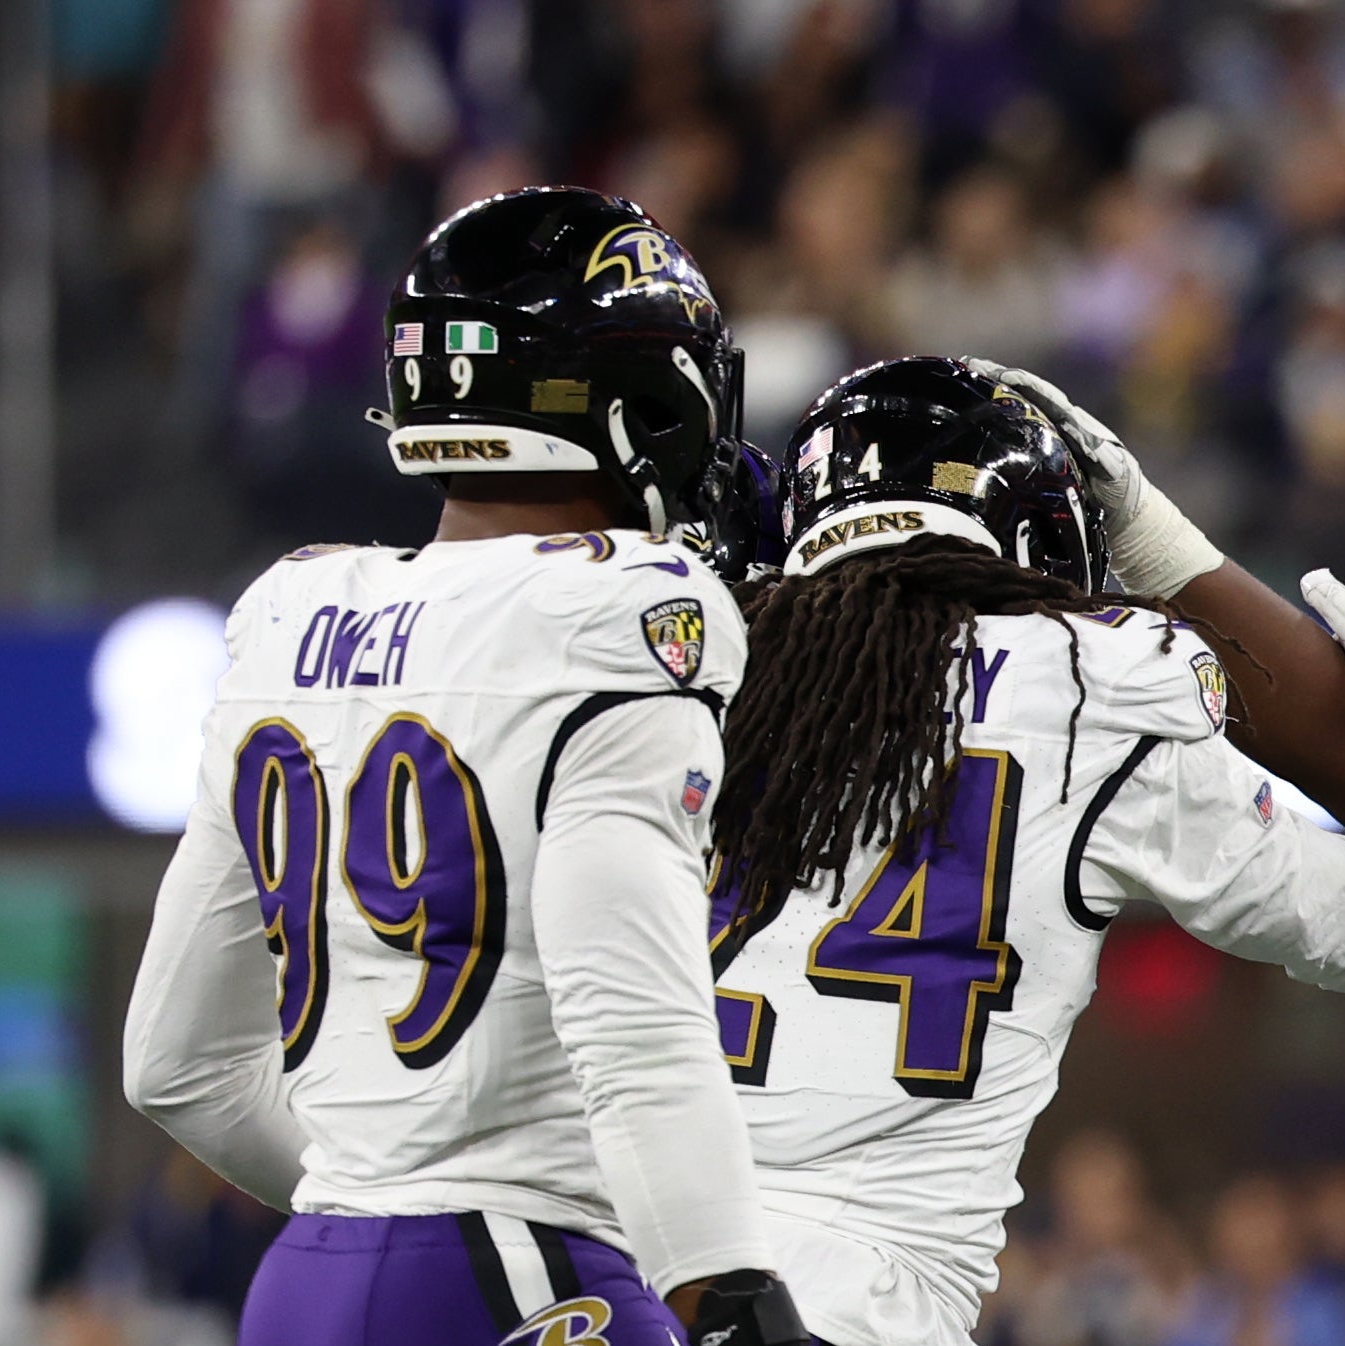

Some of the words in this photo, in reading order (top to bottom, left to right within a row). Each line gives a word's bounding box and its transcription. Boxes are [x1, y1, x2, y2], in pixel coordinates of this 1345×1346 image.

[395, 438, 512, 464] RAVENS
[858, 442, 883, 482] 4
[798, 510, 926, 567] RAVENS
[644, 601, 699, 623] RAVENS
[294, 600, 427, 690] OWEH
[231, 711, 507, 1074] 99
